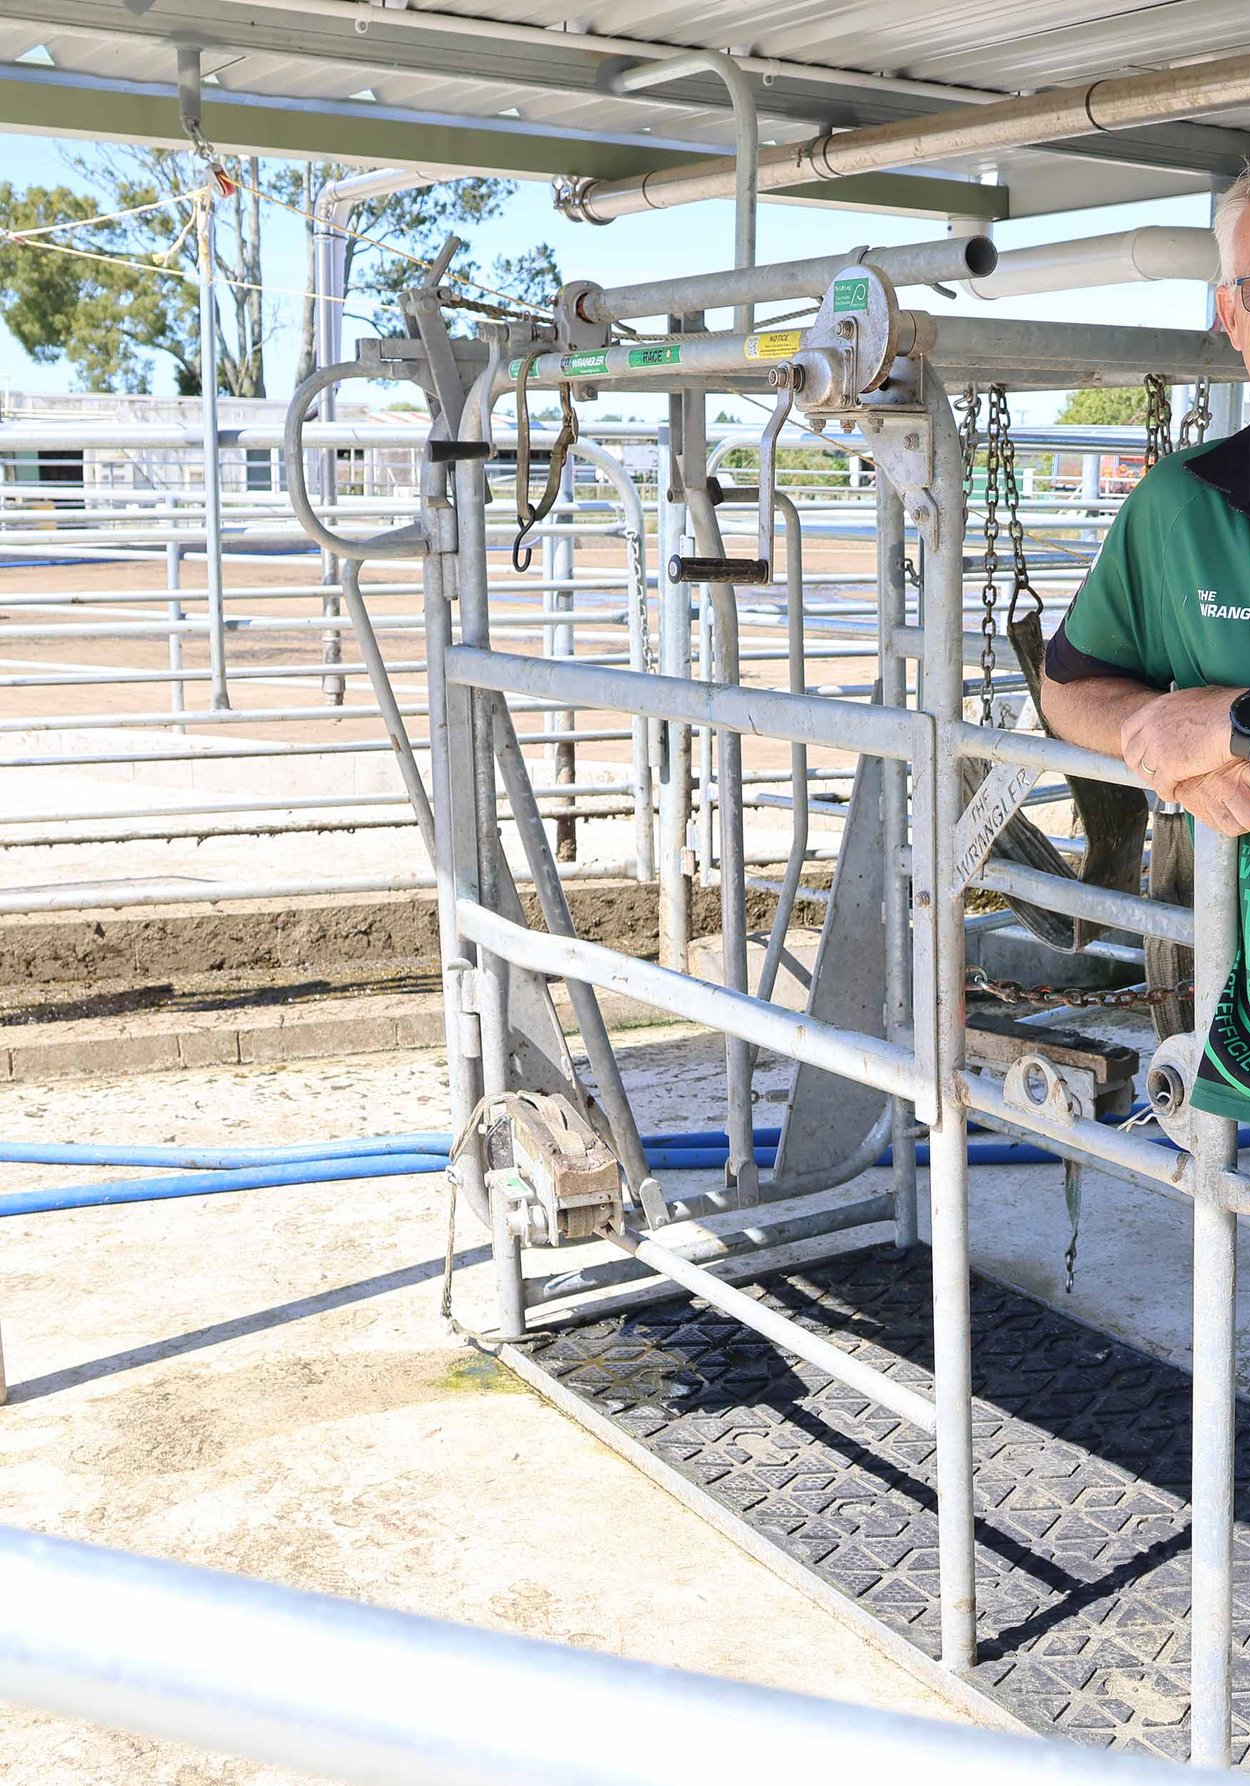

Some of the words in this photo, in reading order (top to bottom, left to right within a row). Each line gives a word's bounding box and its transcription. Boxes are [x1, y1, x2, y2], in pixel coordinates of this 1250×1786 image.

[769, 333, 789, 342] NOTICE
[572, 355, 604, 369] WRANGLER
[642, 349, 662, 363] RACE
[1198, 589, 1217, 602] THE
[971, 788, 990, 823] THE
